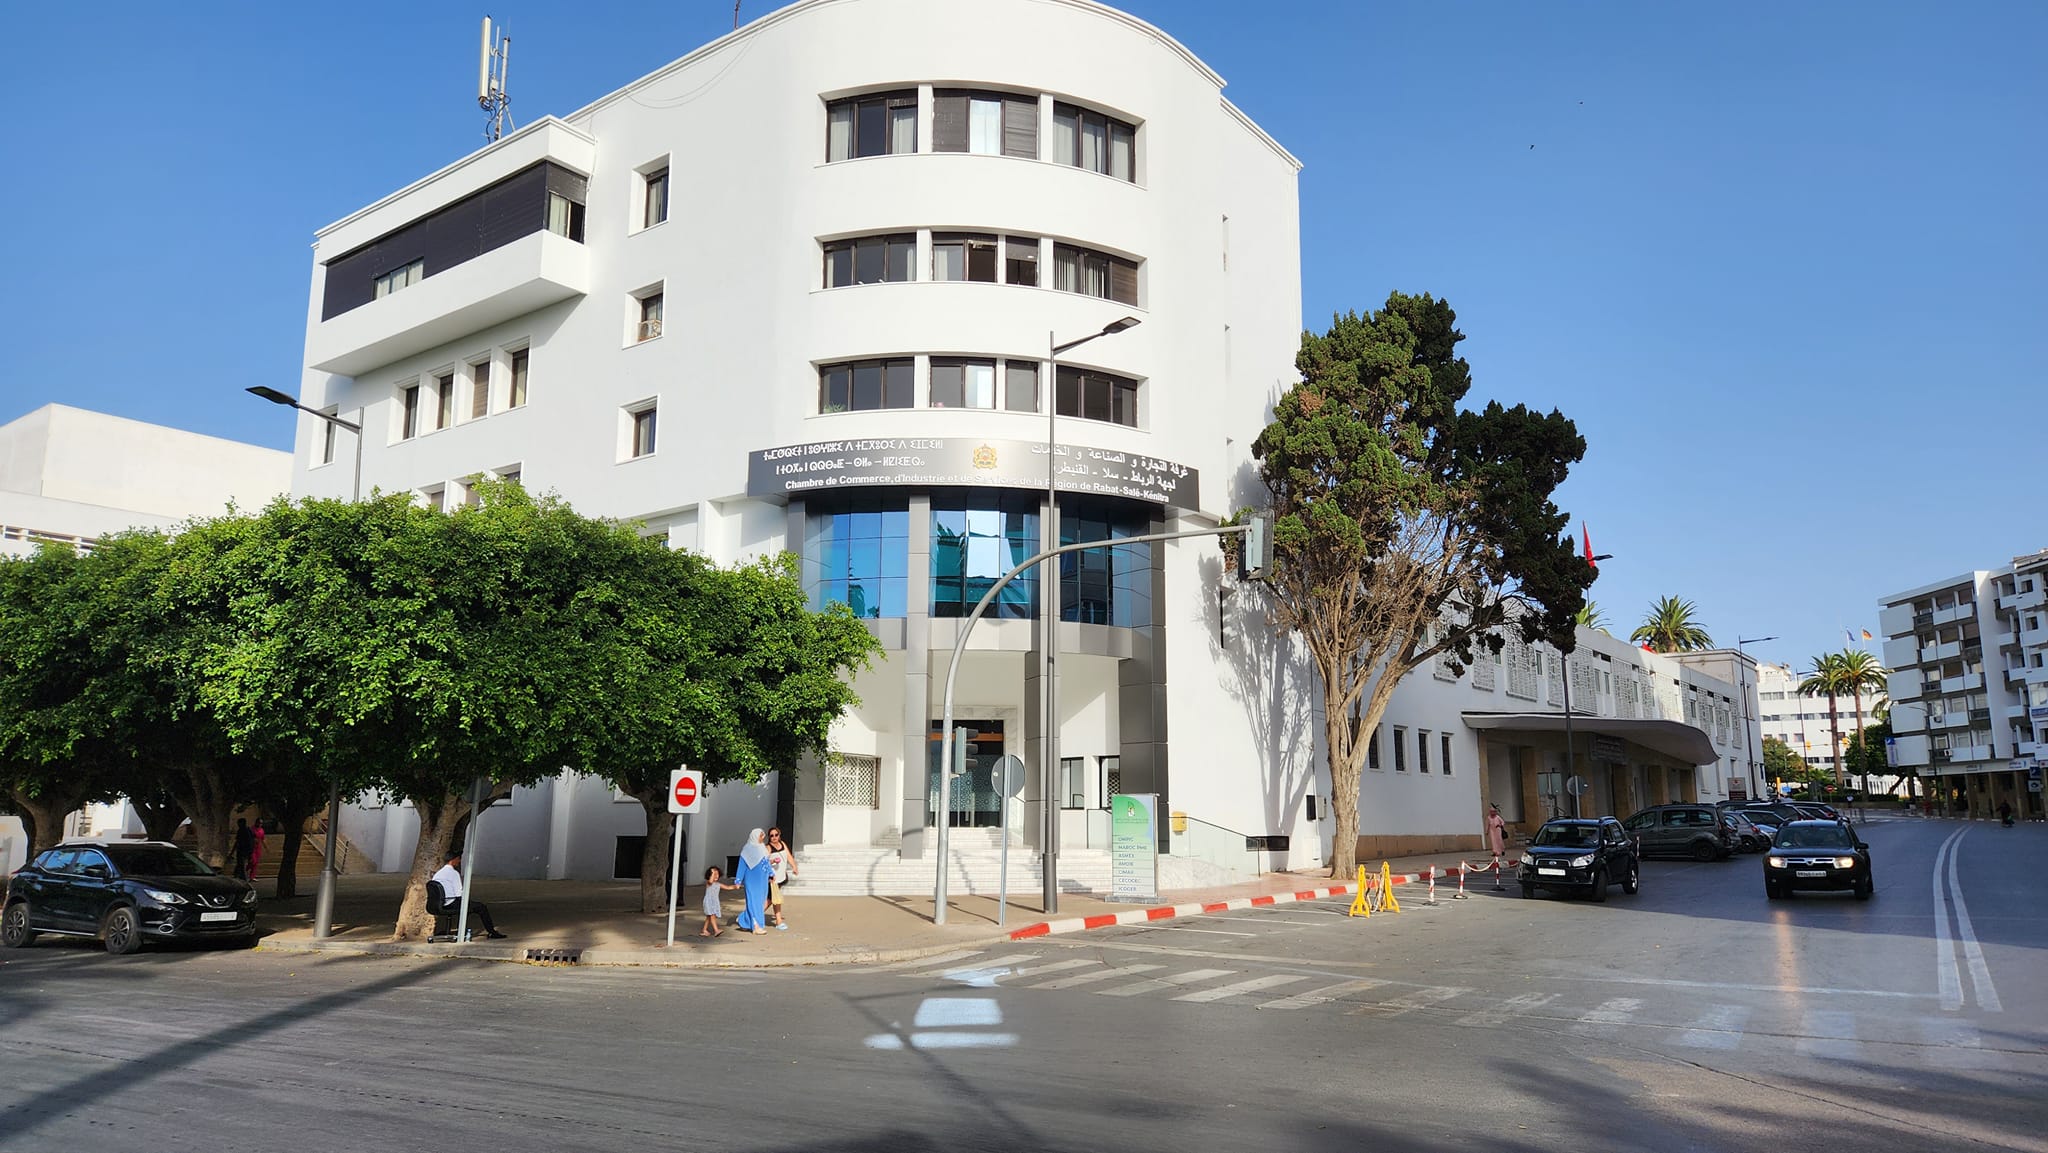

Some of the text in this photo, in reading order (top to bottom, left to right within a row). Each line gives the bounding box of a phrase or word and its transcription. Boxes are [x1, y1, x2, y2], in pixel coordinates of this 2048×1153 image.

[1031, 444, 1188, 479] غرفة التجارة و الصناعة و الخمات
[1102, 467, 1119, 479] سلا
[1130, 470, 1155, 486] الرباط
[785, 478, 824, 490] Chambre
[826, 476, 838, 486] de
[1034, 477, 1042, 486] la
[1080, 482, 1091, 490] de
[1093, 482, 1169, 503] Rabat-Salé-Kénitra
[1157, 475, 1176, 492] لجهة
